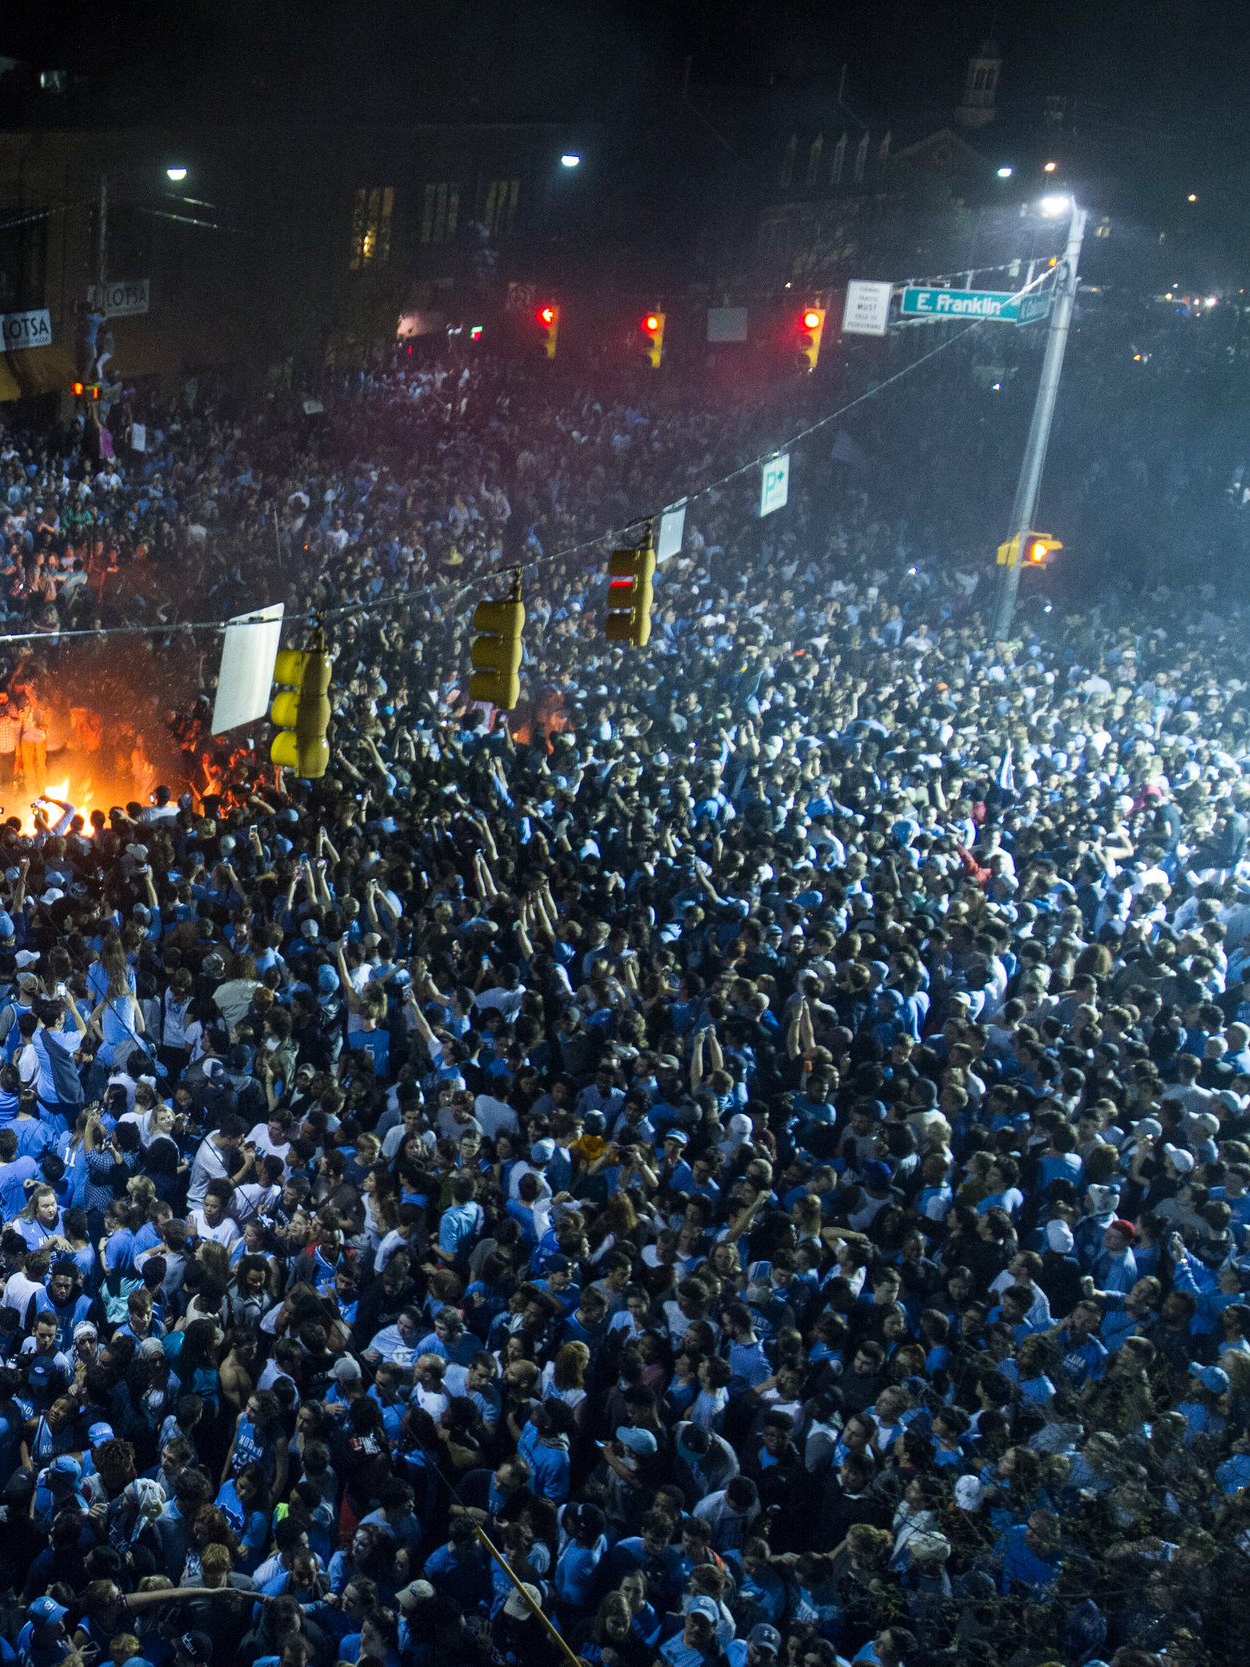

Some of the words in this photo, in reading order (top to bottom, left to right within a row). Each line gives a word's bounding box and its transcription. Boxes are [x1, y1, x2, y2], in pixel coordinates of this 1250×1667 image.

[106, 286, 147, 307] LOTSA
[936, 293, 1001, 315] Franklin
[3, 316, 49, 340] LOTSA
[64, 1146, 76, 1168] 11
[239, 1435, 264, 1458] NORTH
